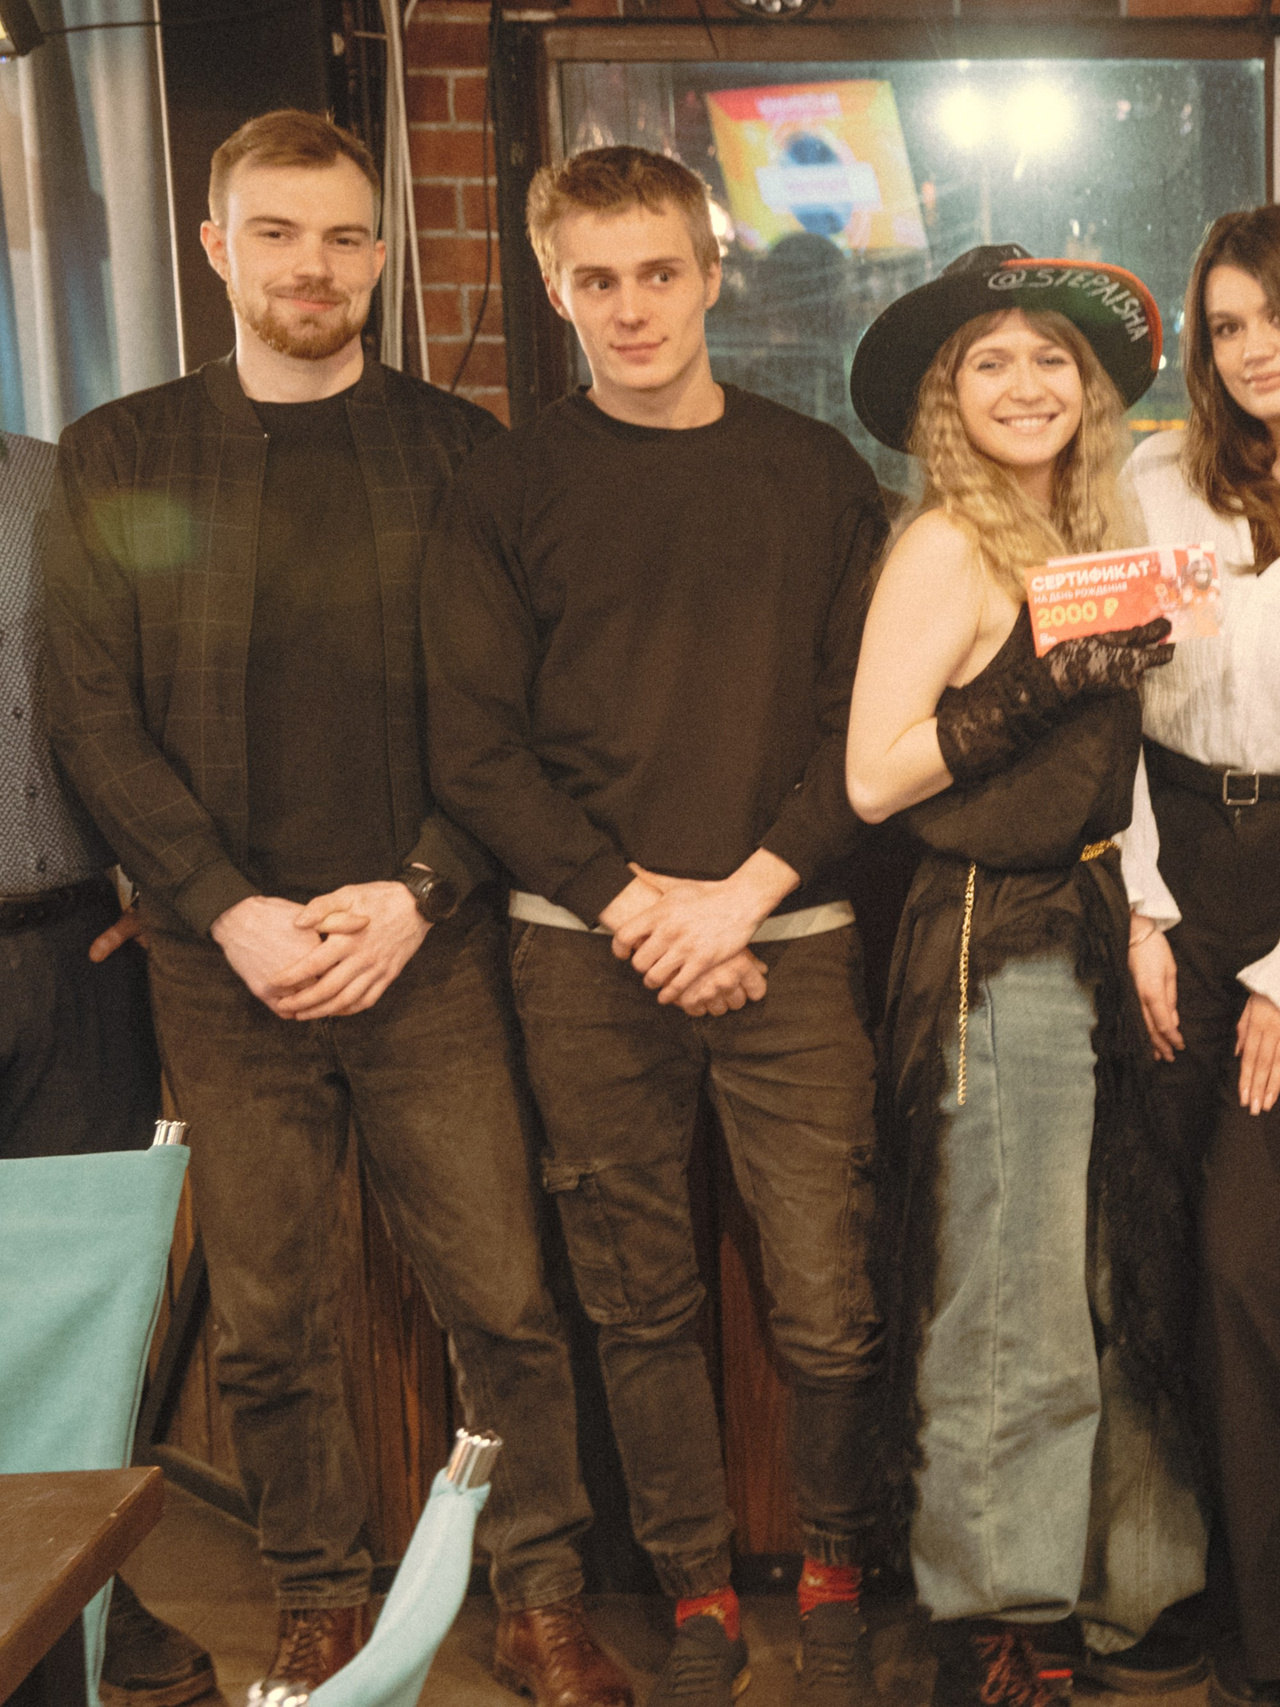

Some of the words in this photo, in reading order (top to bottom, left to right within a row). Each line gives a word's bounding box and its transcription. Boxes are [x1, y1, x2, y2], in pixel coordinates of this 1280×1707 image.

[1031, 560, 1150, 591] СЕРТИФИКАТ
[1034, 593, 1048, 604] НА
[1049, 589, 1074, 603] ДЕНЬ
[1074, 581, 1128, 599] РОЖДЕНИЯ
[1036, 600, 1098, 629] 2000
